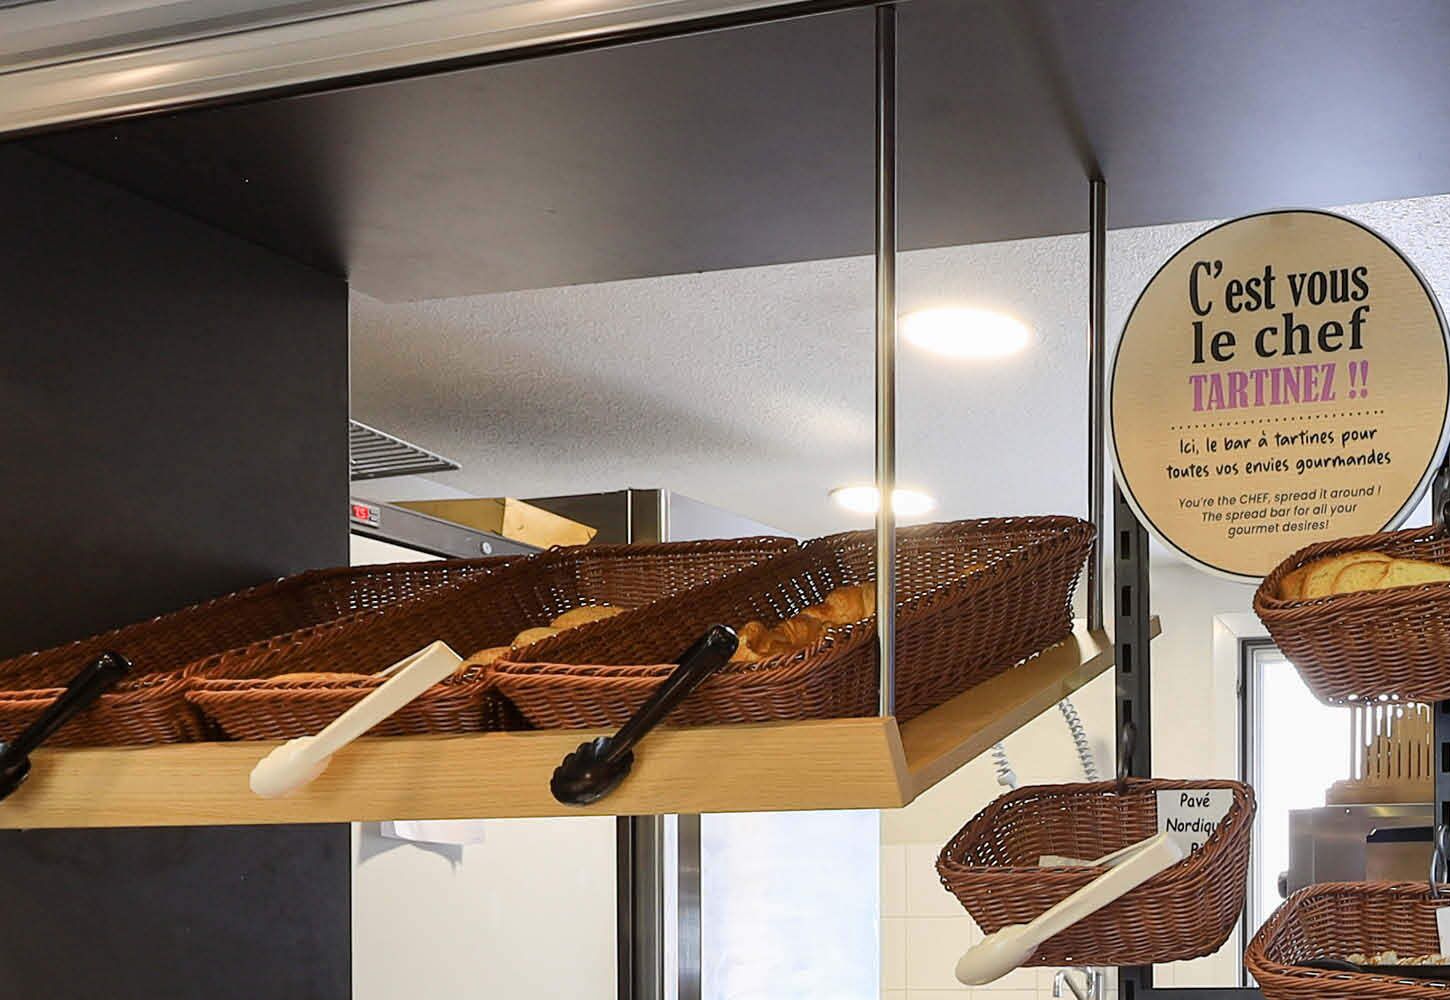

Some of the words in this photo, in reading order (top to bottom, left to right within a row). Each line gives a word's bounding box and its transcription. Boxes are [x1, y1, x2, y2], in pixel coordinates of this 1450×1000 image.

[1287, 266, 1369, 308] vous
[1192, 321, 1236, 364] le
[1255, 305, 1370, 358] chef
[1189, 363, 1337, 412] TARTINEZ
[1349, 360, 1369, 399] !!
[1179, 438, 1200, 455] Ici,
[1206, 437, 1218, 453] le
[1224, 434, 1251, 451] bar
[1257, 430, 1269, 448] à
[1275, 429, 1335, 446] tartines
[1341, 427, 1378, 450] pour
[1165, 462, 1210, 480] toutes
[1215, 464, 1239, 477] vos
[1246, 459, 1289, 476] envies
[1296, 450, 1392, 478] gourmandes
[1178, 496, 1218, 510] You're
[1220, 494, 1237, 506] the
[1274, 488, 1317, 507] spread
[1319, 487, 1328, 499] it
[1330, 485, 1375, 499] around
[1201, 511, 1223, 523] The
[1225, 507, 1267, 525] spread
[1269, 506, 1292, 519] bar
[1294, 505, 1311, 517] for
[1312, 503, 1328, 516] all
[1330, 503, 1358, 519] your
[1227, 522, 1280, 538] gourmet
[1282, 519, 1329, 533] desires!
[1180, 792, 1210, 808] Pavé
